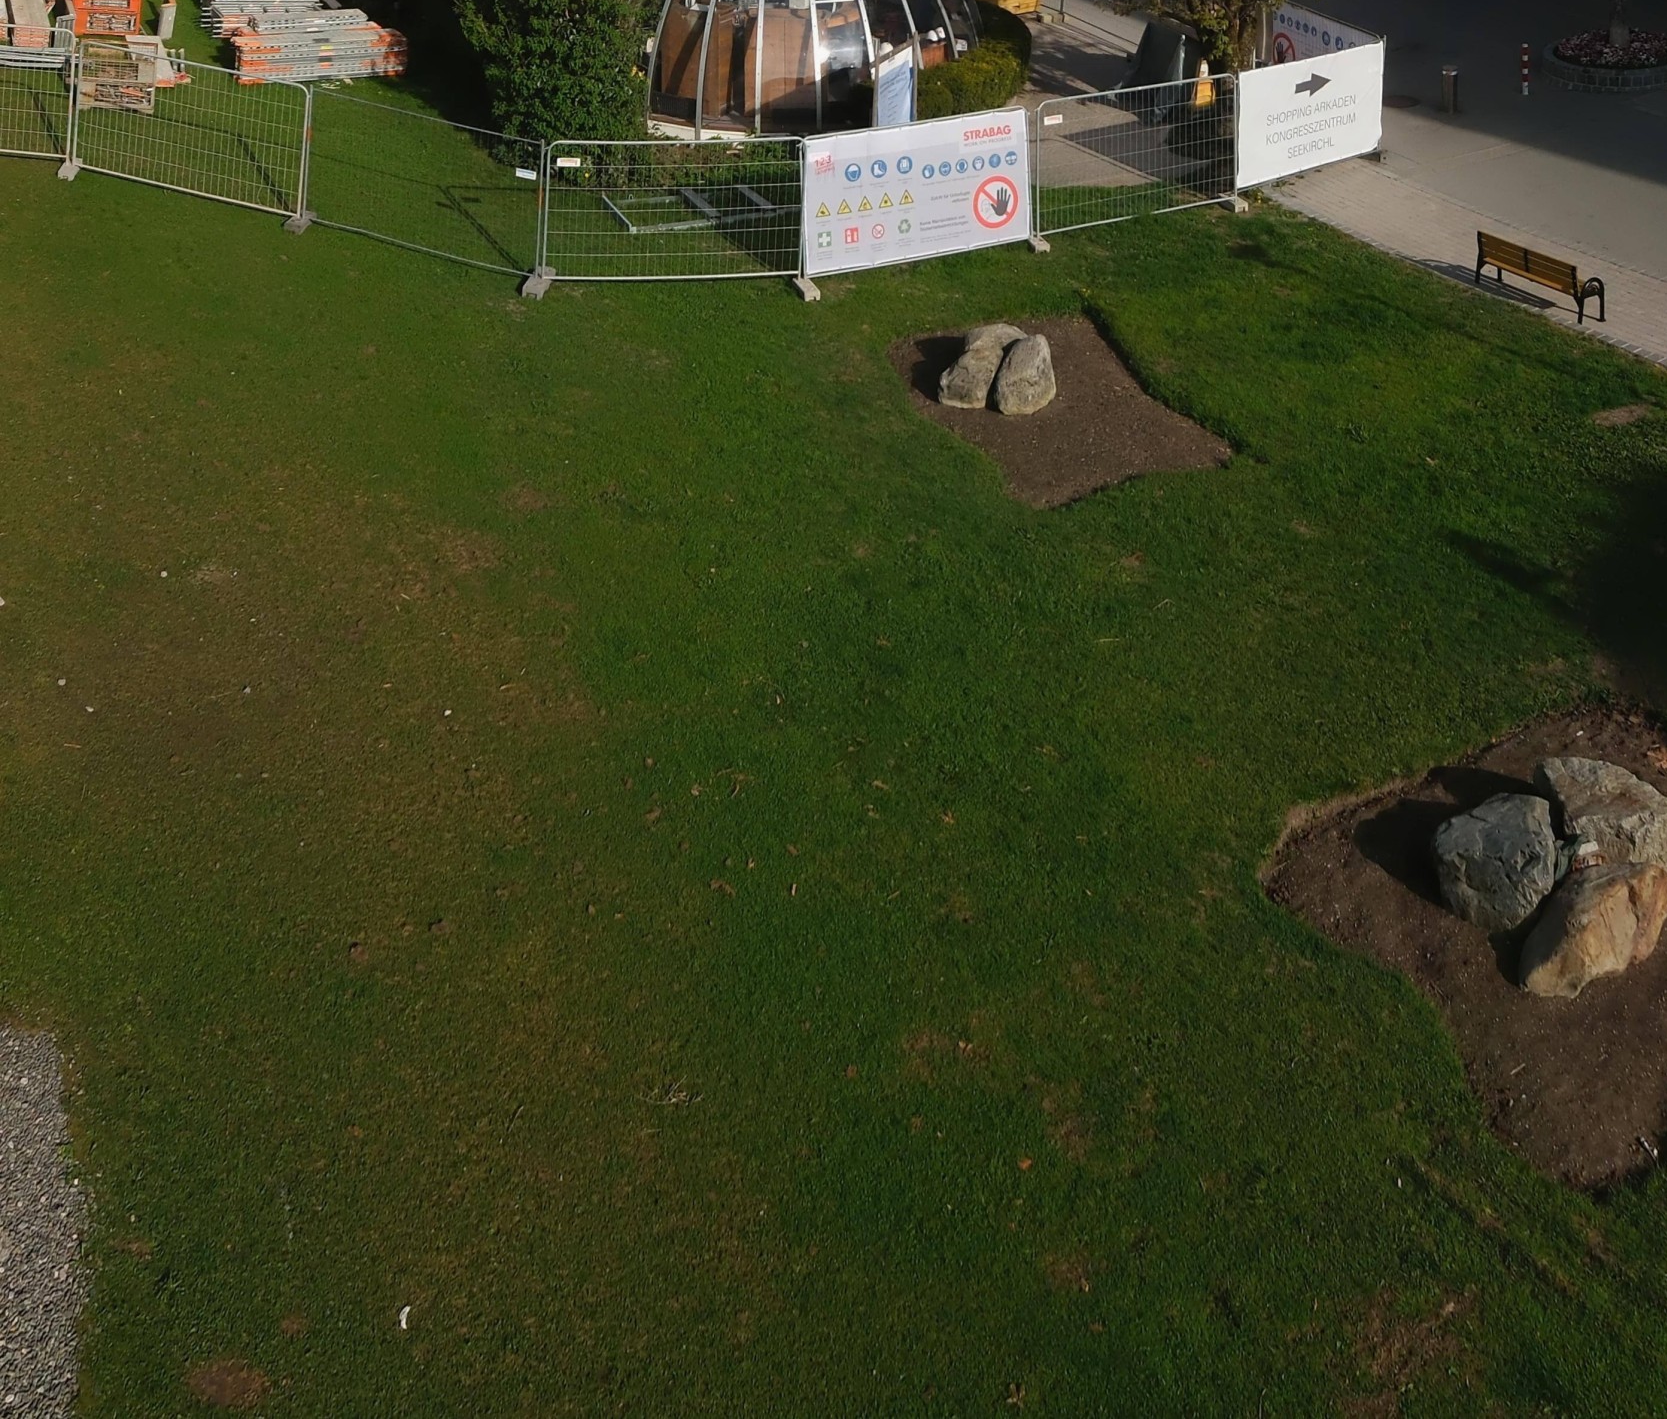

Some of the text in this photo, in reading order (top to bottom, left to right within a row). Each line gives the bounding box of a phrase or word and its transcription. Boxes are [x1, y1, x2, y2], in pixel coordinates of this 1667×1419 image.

[1266, 94, 1356, 127] SHOPPING ARKADEN
[963, 124, 1012, 142] STRABAG
[1265, 112, 1356, 145] KONGRESSZENTRUM
[1287, 138, 1335, 160] SEEKIRCHL
